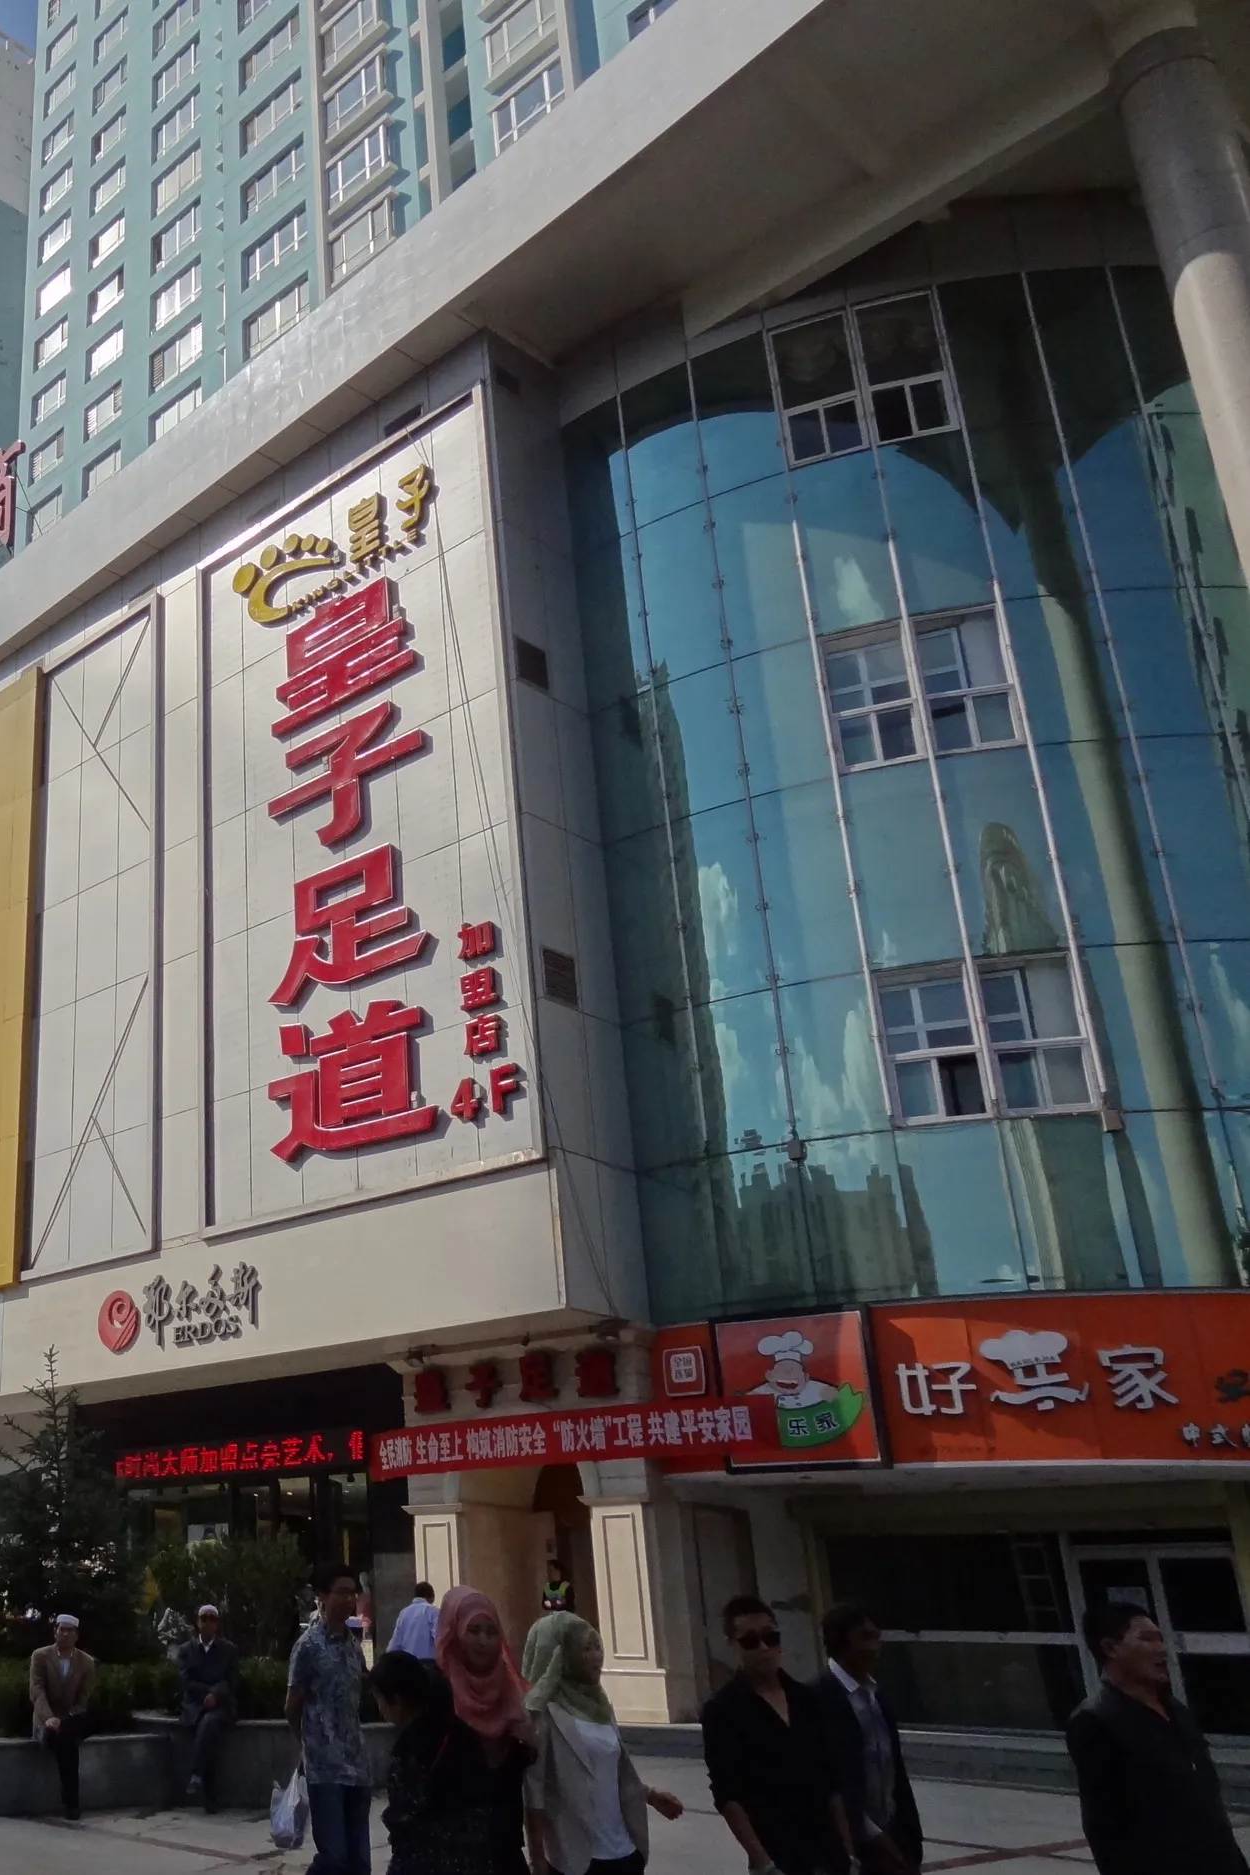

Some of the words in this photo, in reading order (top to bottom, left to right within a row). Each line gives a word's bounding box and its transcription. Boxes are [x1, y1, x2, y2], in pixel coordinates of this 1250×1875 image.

[348, 464, 433, 564] 皇子
[267, 575, 442, 1165] 皇子足道
[456, 920, 500, 1057] 加盟店
[450, 1062, 520, 1121] 4F
[143, 1261, 260, 1348] 鄂尔多斯
[172, 1315, 242, 1344] ERDOS
[379, 1435, 412, 1470] 全民消防
[416, 1430, 464, 1465] 生命至上
[466, 1422, 547, 1460] 构筑消防安全
[647, 1406, 753, 1445] 共建平安家园
